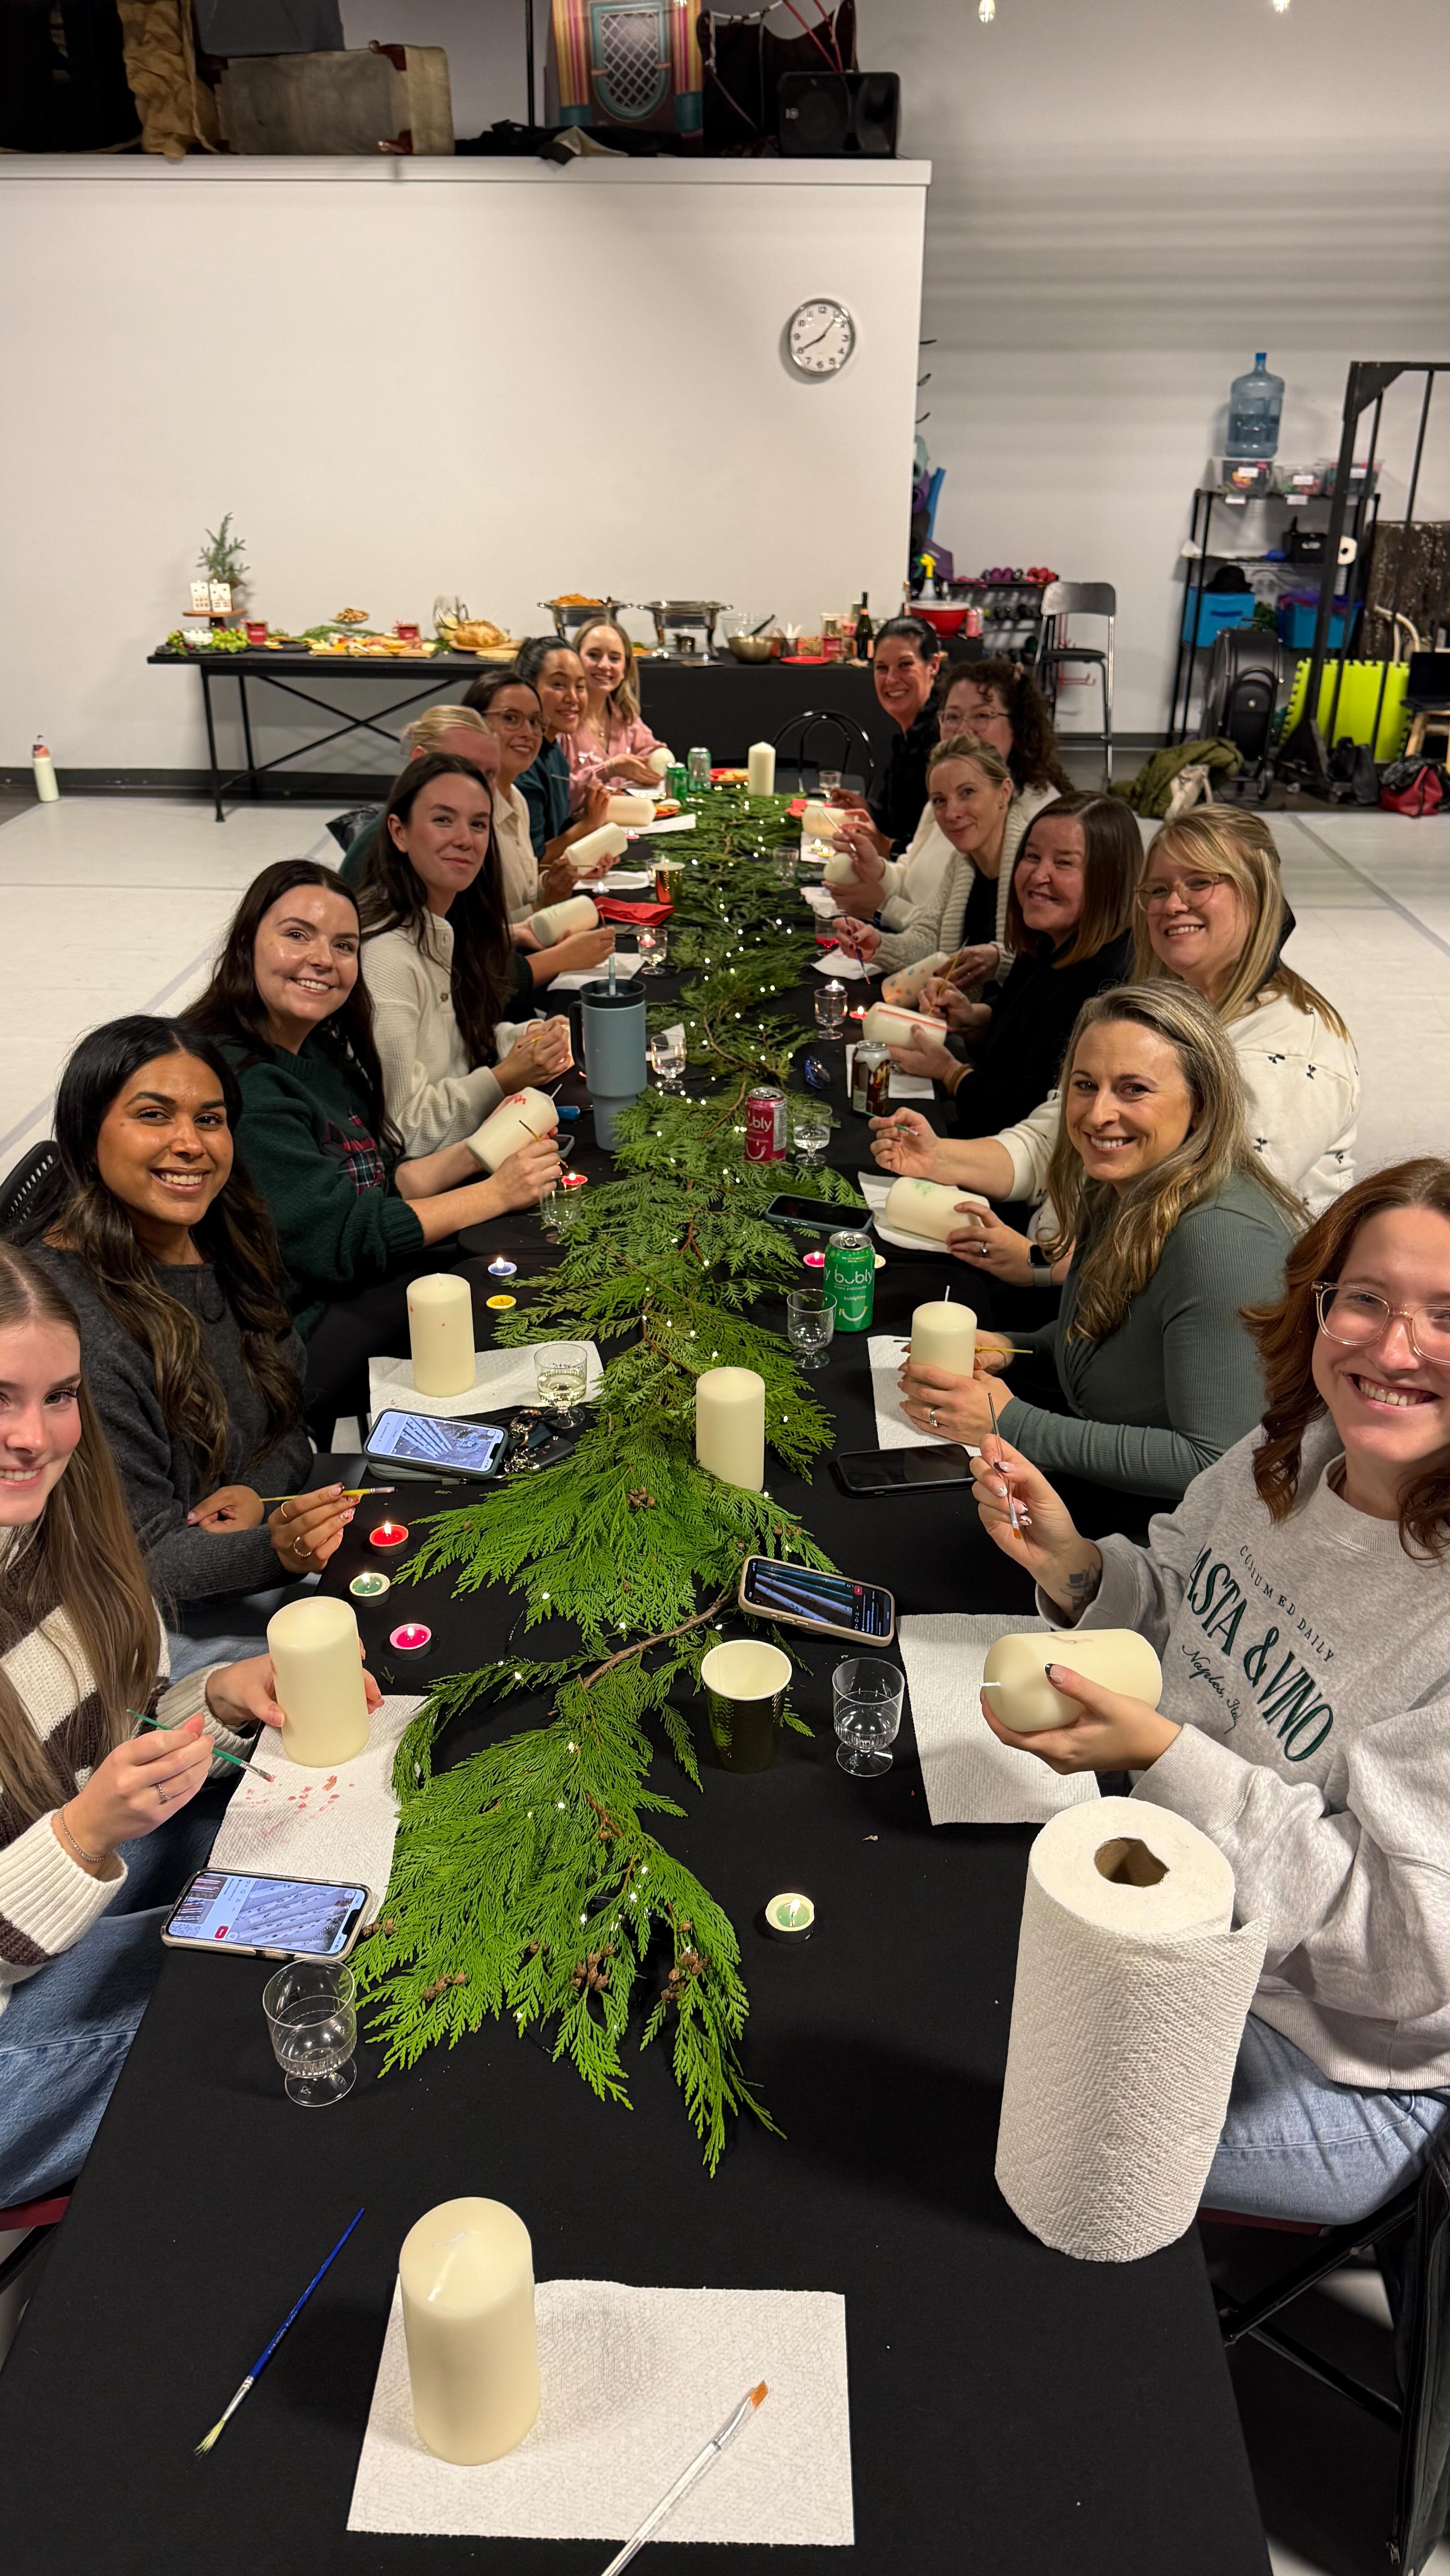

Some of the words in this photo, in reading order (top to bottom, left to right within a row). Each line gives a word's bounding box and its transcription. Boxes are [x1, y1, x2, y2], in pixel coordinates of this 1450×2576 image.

[834, 1268, 873, 1285] bubly
[1187, 1544, 1247, 1656] ASTA
[1240, 1545, 1296, 1616] CONSUMED
[1297, 1617, 1334, 1662] DAILY
[1182, 1645, 1225, 1698] Naples,
[1222, 1698, 1242, 1735] Italy
[1243, 1626, 1280, 1688] &
[1256, 1651, 1334, 1762] VINO
